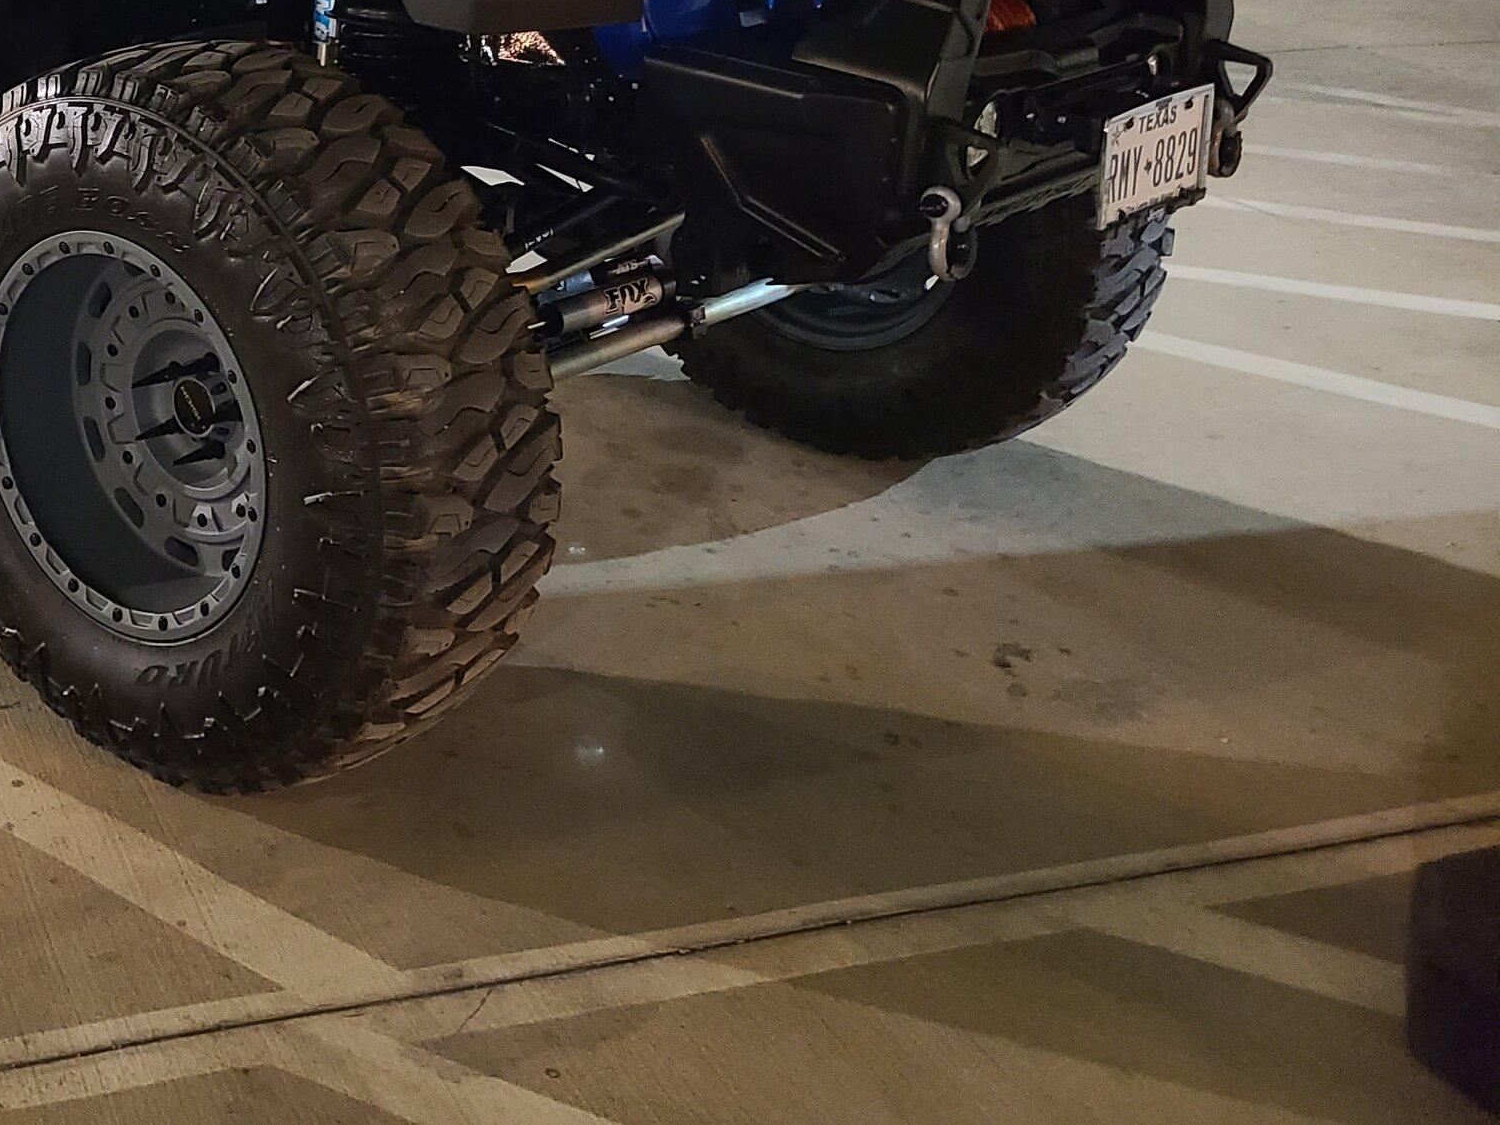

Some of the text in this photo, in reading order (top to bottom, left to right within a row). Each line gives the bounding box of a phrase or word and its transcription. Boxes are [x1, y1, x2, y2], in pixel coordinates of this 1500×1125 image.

[1139, 104, 1178, 134] TEXAS
[1108, 128, 1198, 205] RMY 8829
[603, 277, 656, 314] FOX
